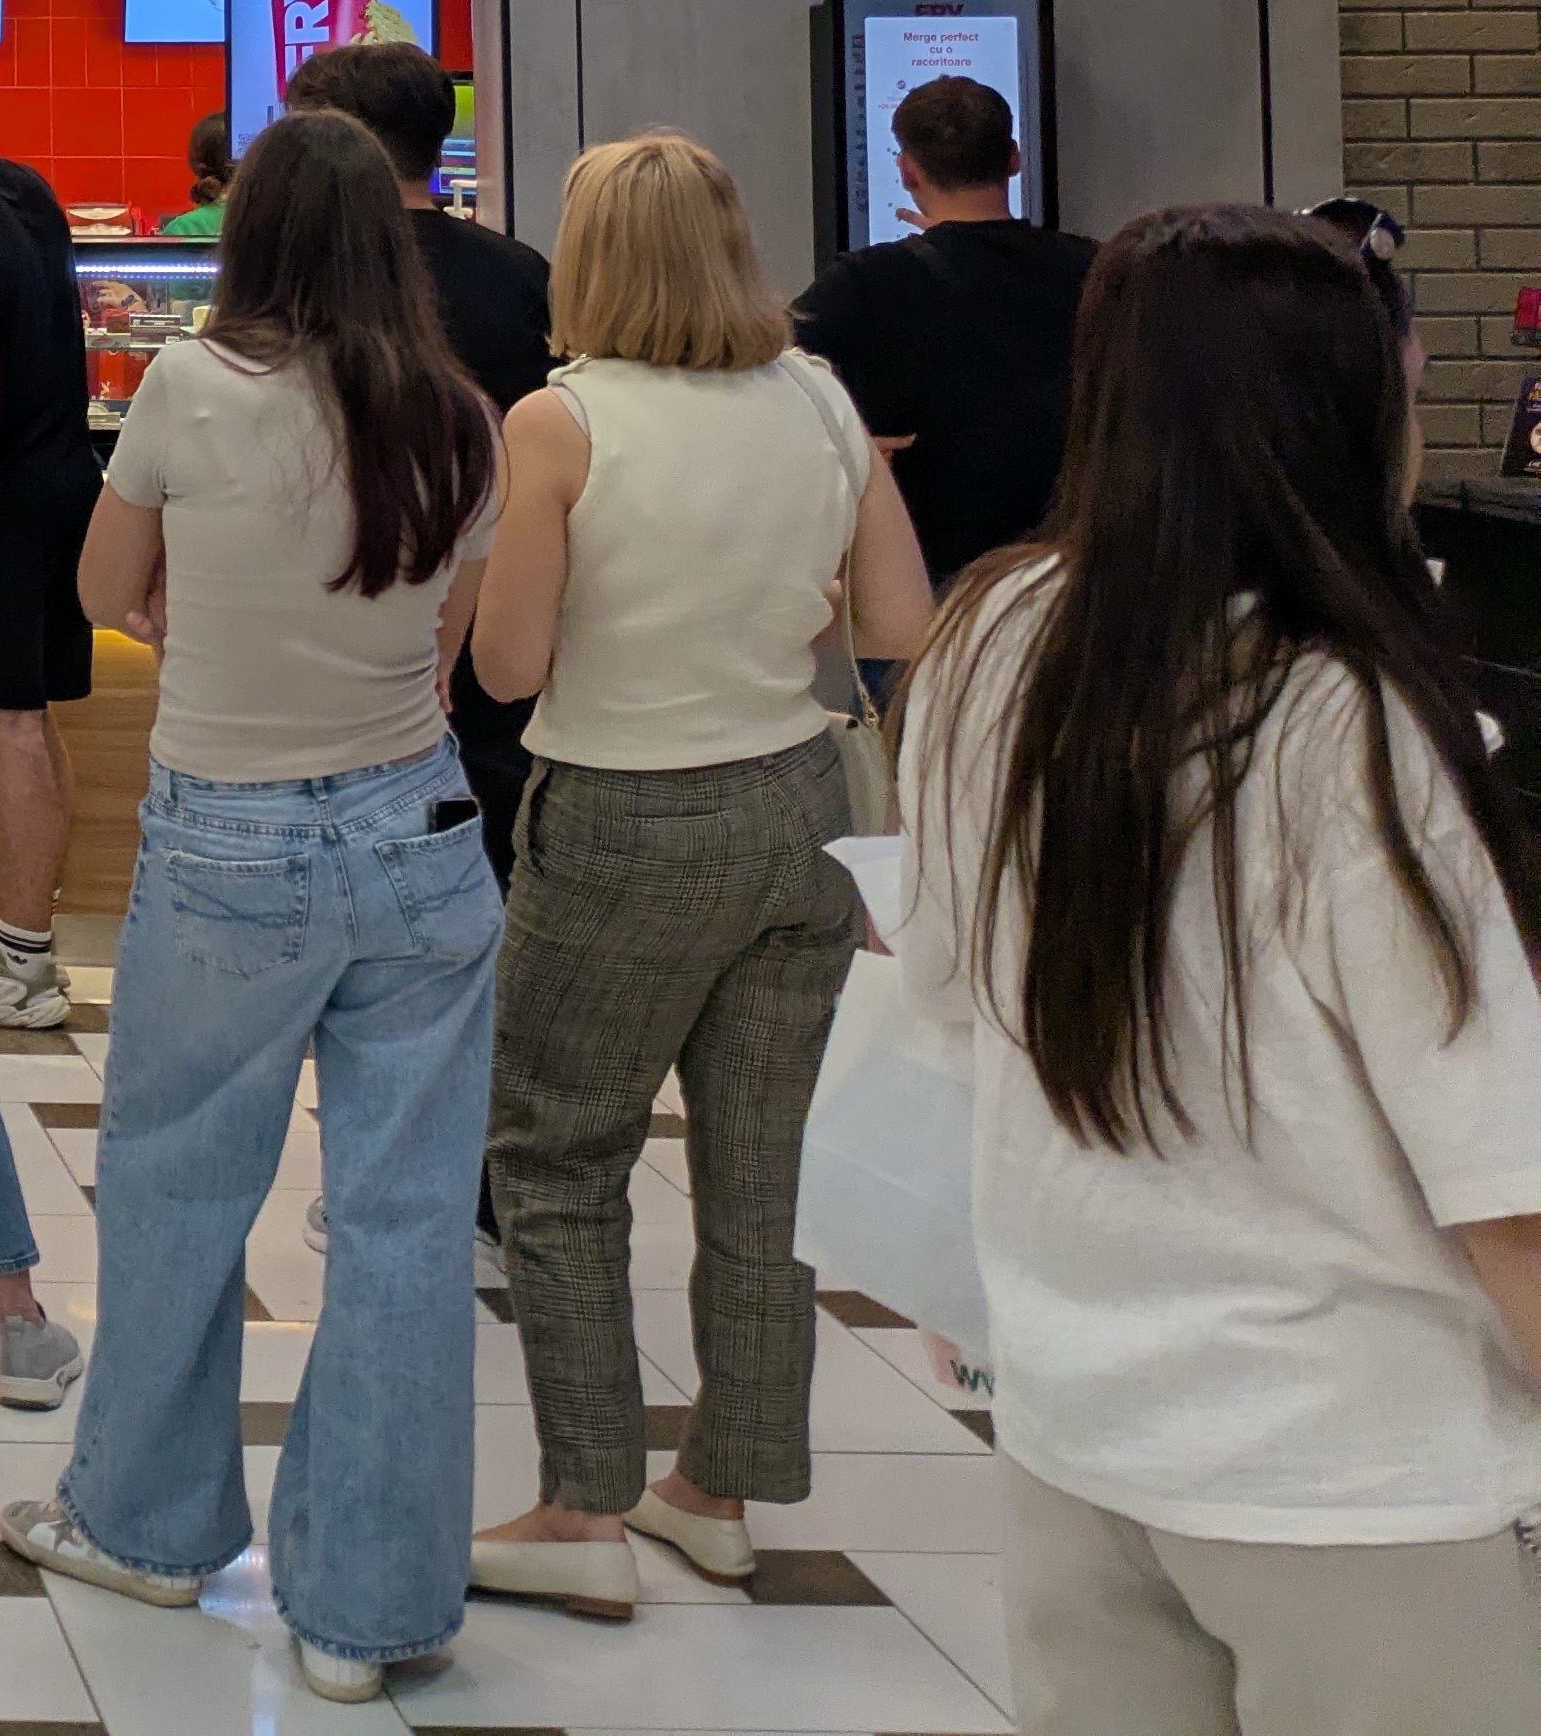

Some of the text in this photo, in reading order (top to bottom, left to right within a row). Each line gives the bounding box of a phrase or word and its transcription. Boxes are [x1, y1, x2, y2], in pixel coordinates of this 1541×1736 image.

[903, 31, 979, 43] Merge perfect
[929, 46, 953, 54] cu o
[911, 57, 972, 67] racoritoare
